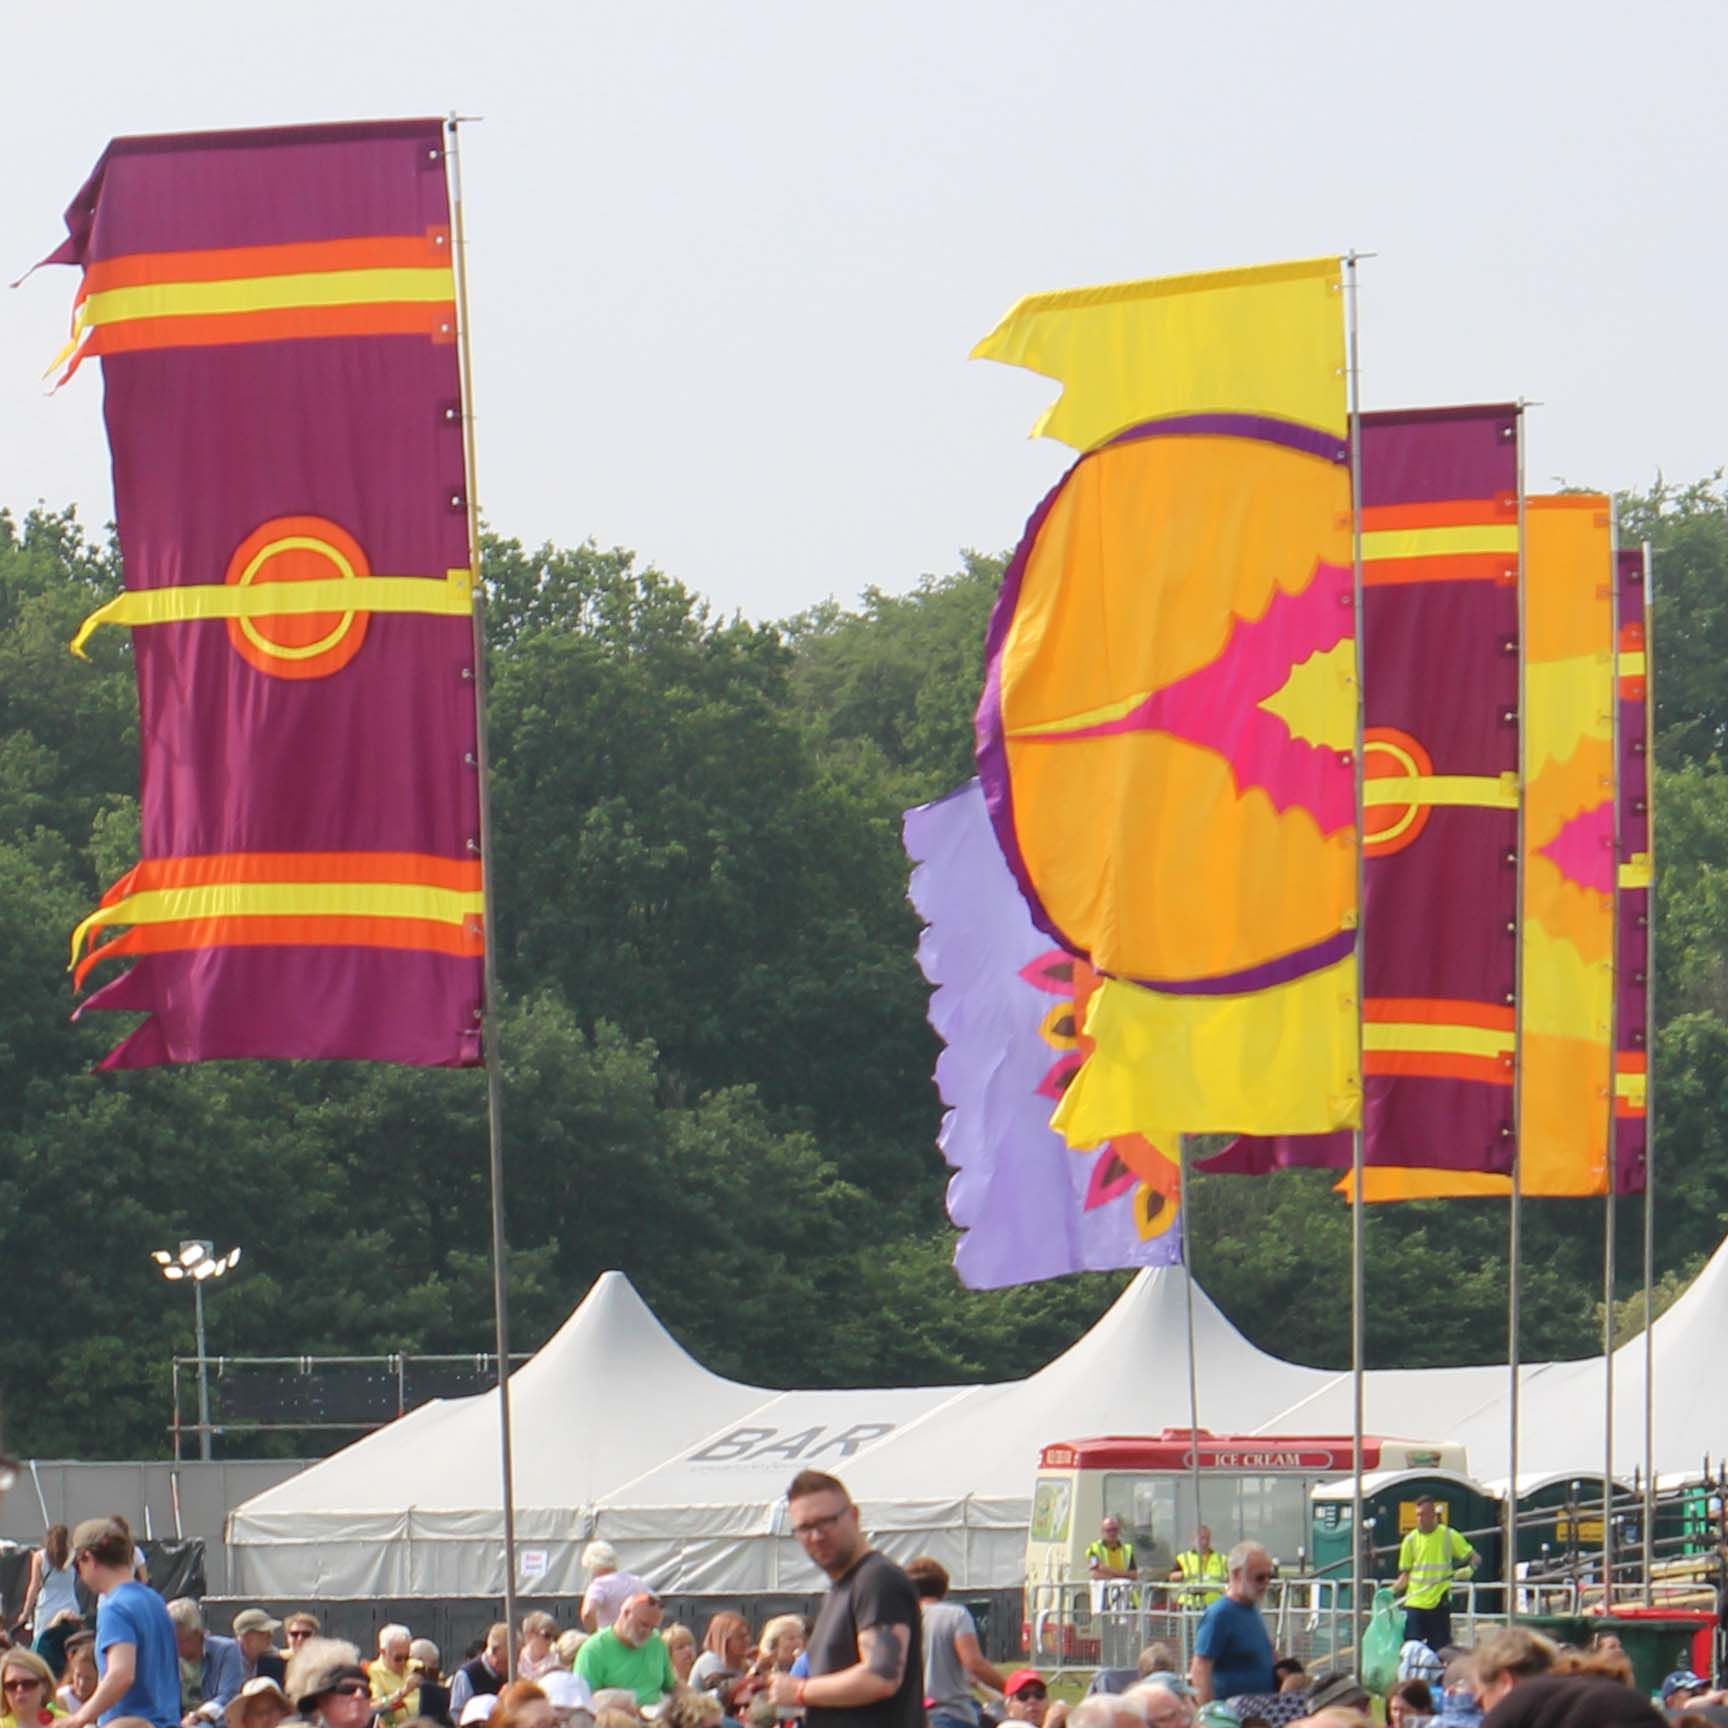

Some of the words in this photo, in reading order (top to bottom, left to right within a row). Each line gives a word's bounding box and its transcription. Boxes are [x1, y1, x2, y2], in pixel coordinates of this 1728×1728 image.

[686, 1423, 896, 1462] BAR
[1214, 1453, 1239, 1467] ICE
[1243, 1453, 1301, 1467] CREAM
